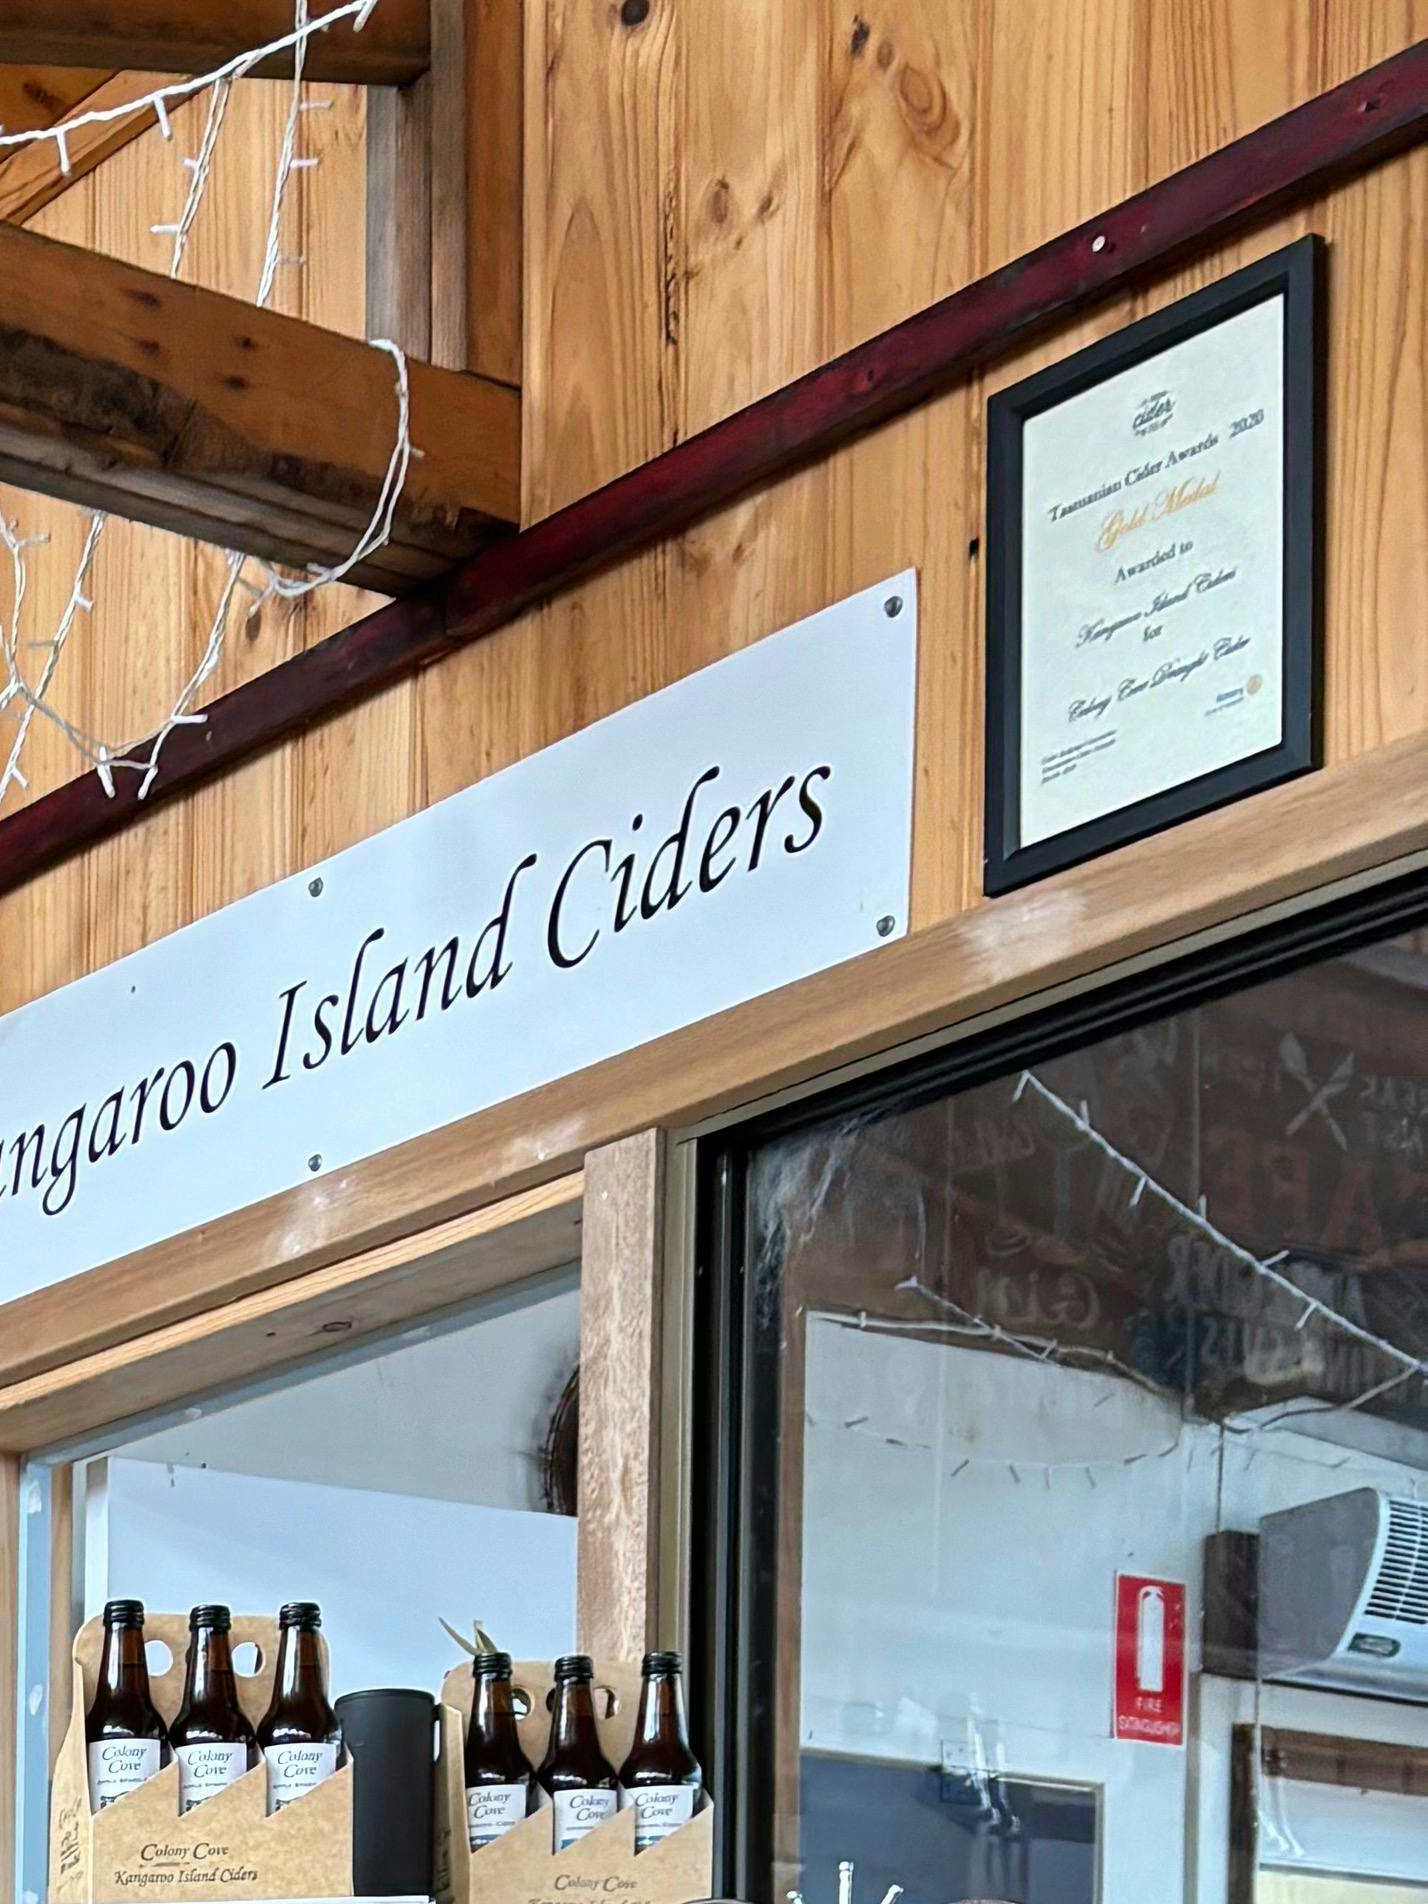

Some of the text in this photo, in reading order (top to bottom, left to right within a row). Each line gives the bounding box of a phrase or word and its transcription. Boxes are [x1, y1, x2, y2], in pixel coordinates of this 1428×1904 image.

[1124, 461, 1163, 487] Cider
[1164, 433, 1219, 469] Awards
[1114, 541, 1194, 585] Awarded to
[261, 851, 537, 1089] Island
[546, 763, 833, 969] Ciders
[101, 1744, 148, 1762] Colony
[186, 1749, 233, 1766] Colony
[276, 1749, 323, 1766] Colony
[107, 1760, 142, 1774] Cove
[193, 1764, 227, 1778] Cove
[282, 1764, 318, 1779] Cove
[139, 1842, 192, 1861] Colony
[113, 1866, 259, 1888] Kangaroo Island Ciders
